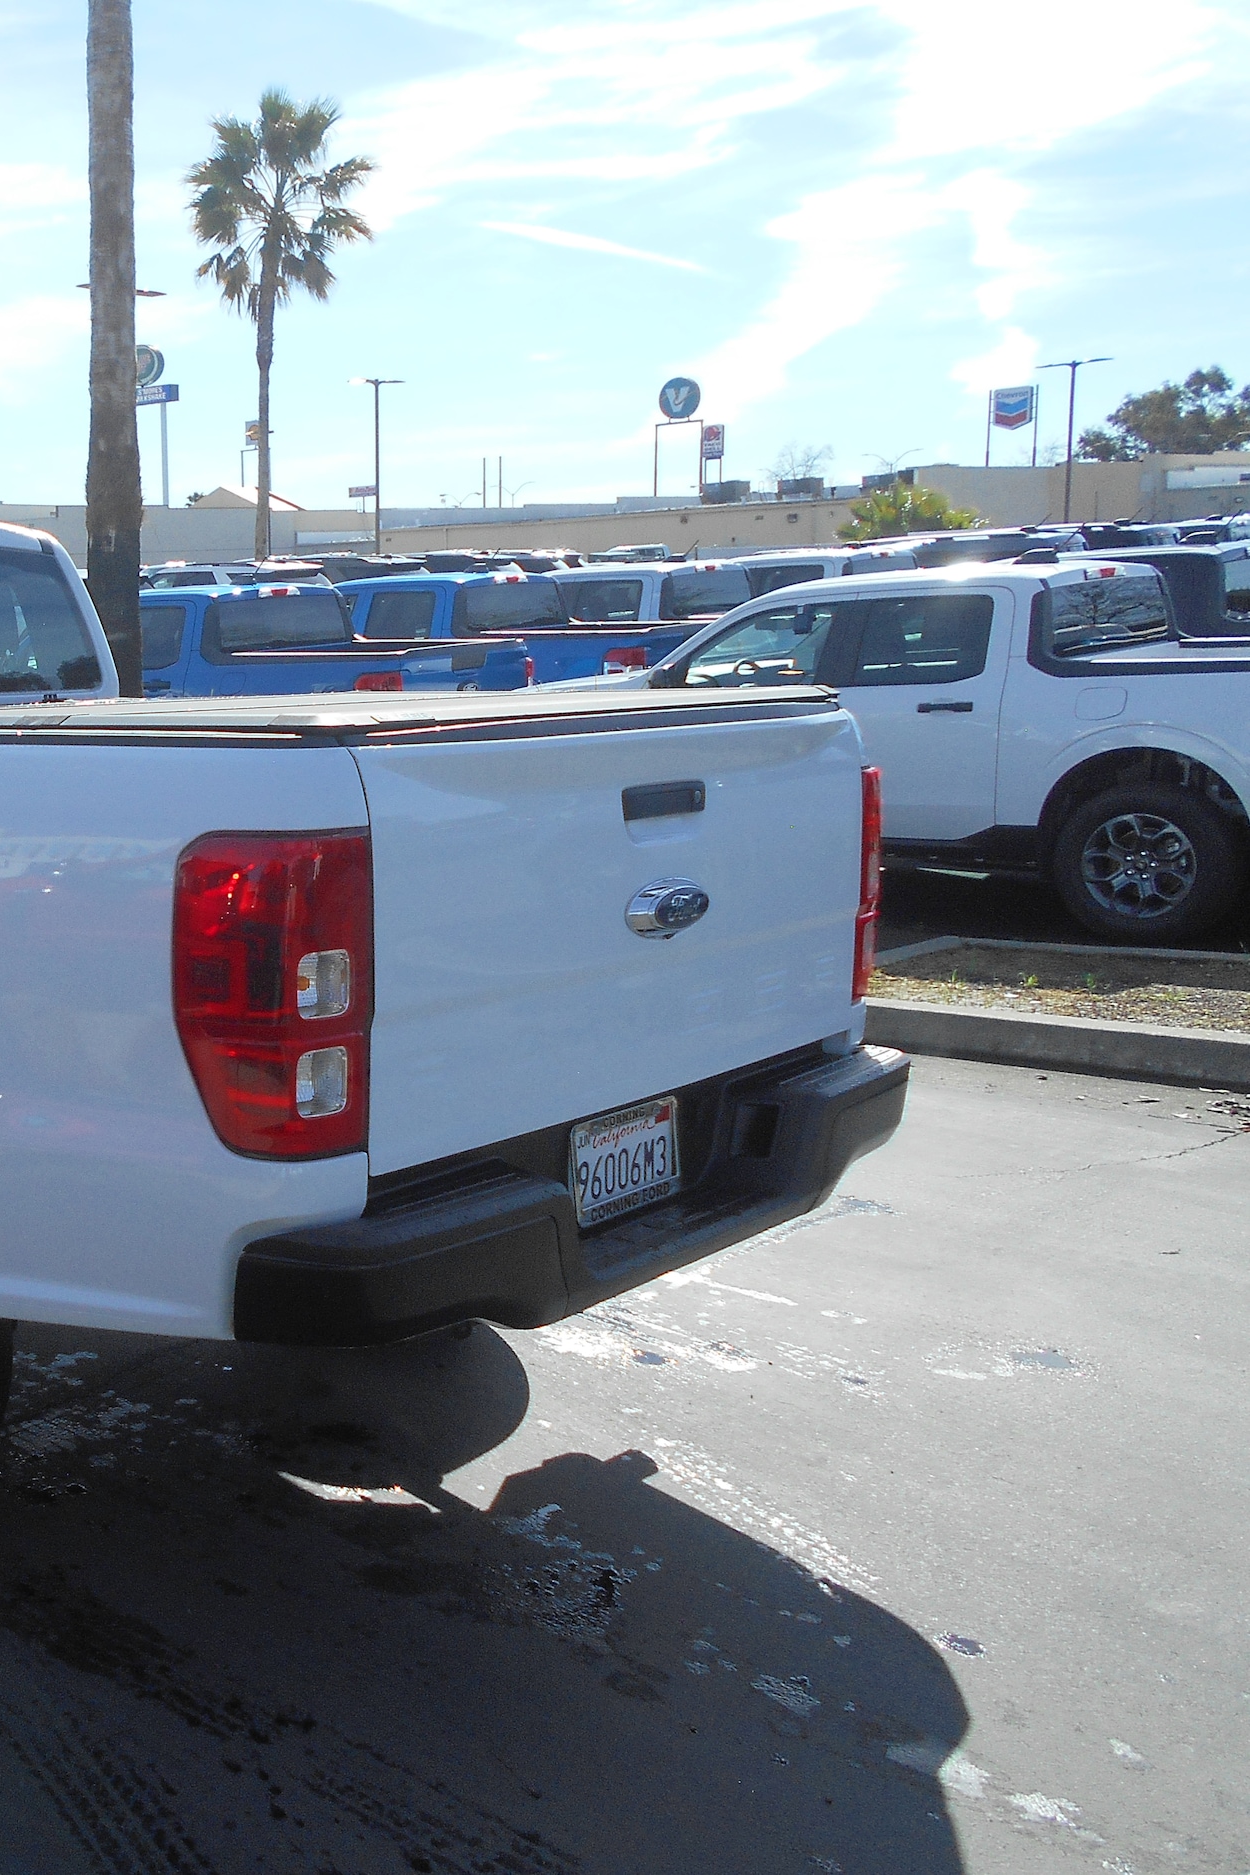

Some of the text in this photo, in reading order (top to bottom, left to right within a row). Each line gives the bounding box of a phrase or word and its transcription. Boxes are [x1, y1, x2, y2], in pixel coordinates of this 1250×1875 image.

[995, 390, 1029, 400] Chevron
[602, 1106, 646, 1128] CORNING
[591, 1118, 656, 1150] California
[578, 1134, 667, 1203] 96006M3
[590, 1182, 670, 1222] CORNING FORD
